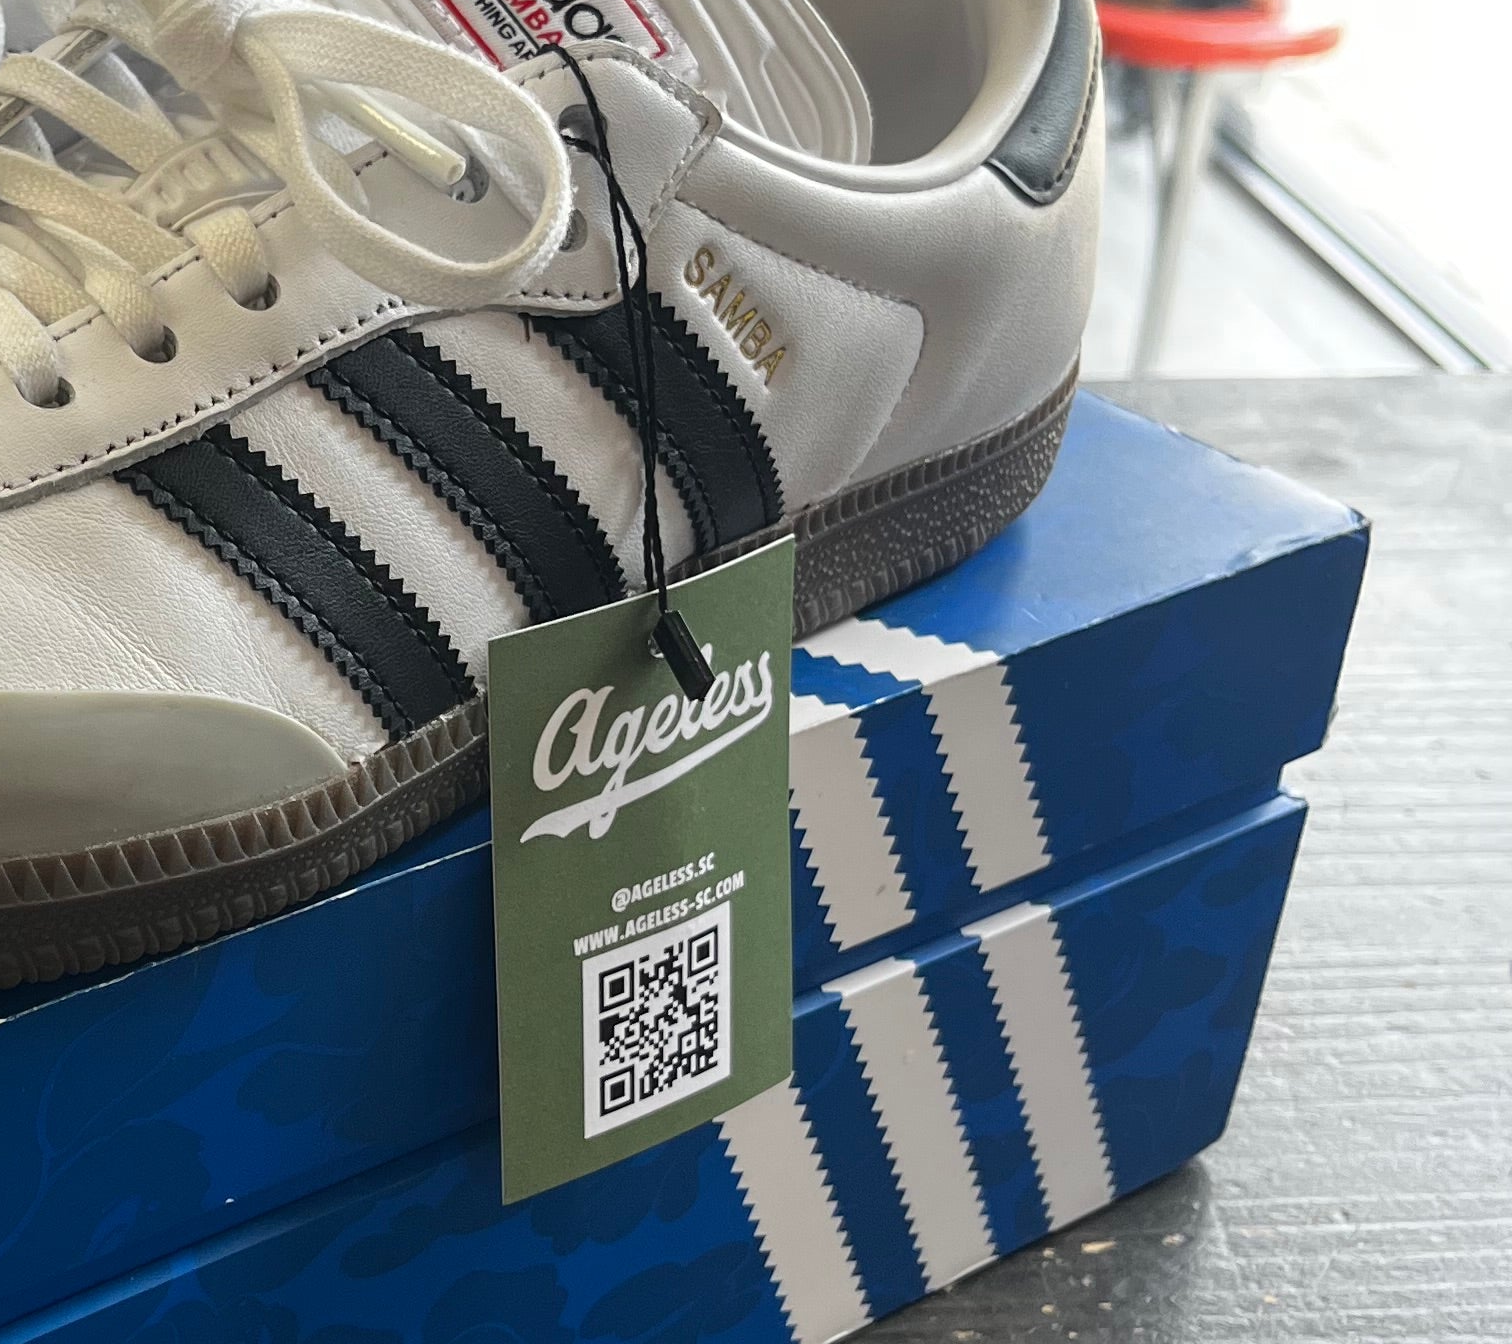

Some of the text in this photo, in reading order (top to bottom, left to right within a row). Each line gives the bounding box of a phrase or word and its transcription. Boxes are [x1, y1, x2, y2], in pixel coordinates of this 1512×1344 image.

[508, 40, 537, 61] AP
[683, 246, 787, 387] SAMBA
[528, 643, 772, 840] Ageless
[573, 869, 745, 957] WWW.AGELESS-SC.COM
[610, 851, 715, 913] @AGELESS.SC
